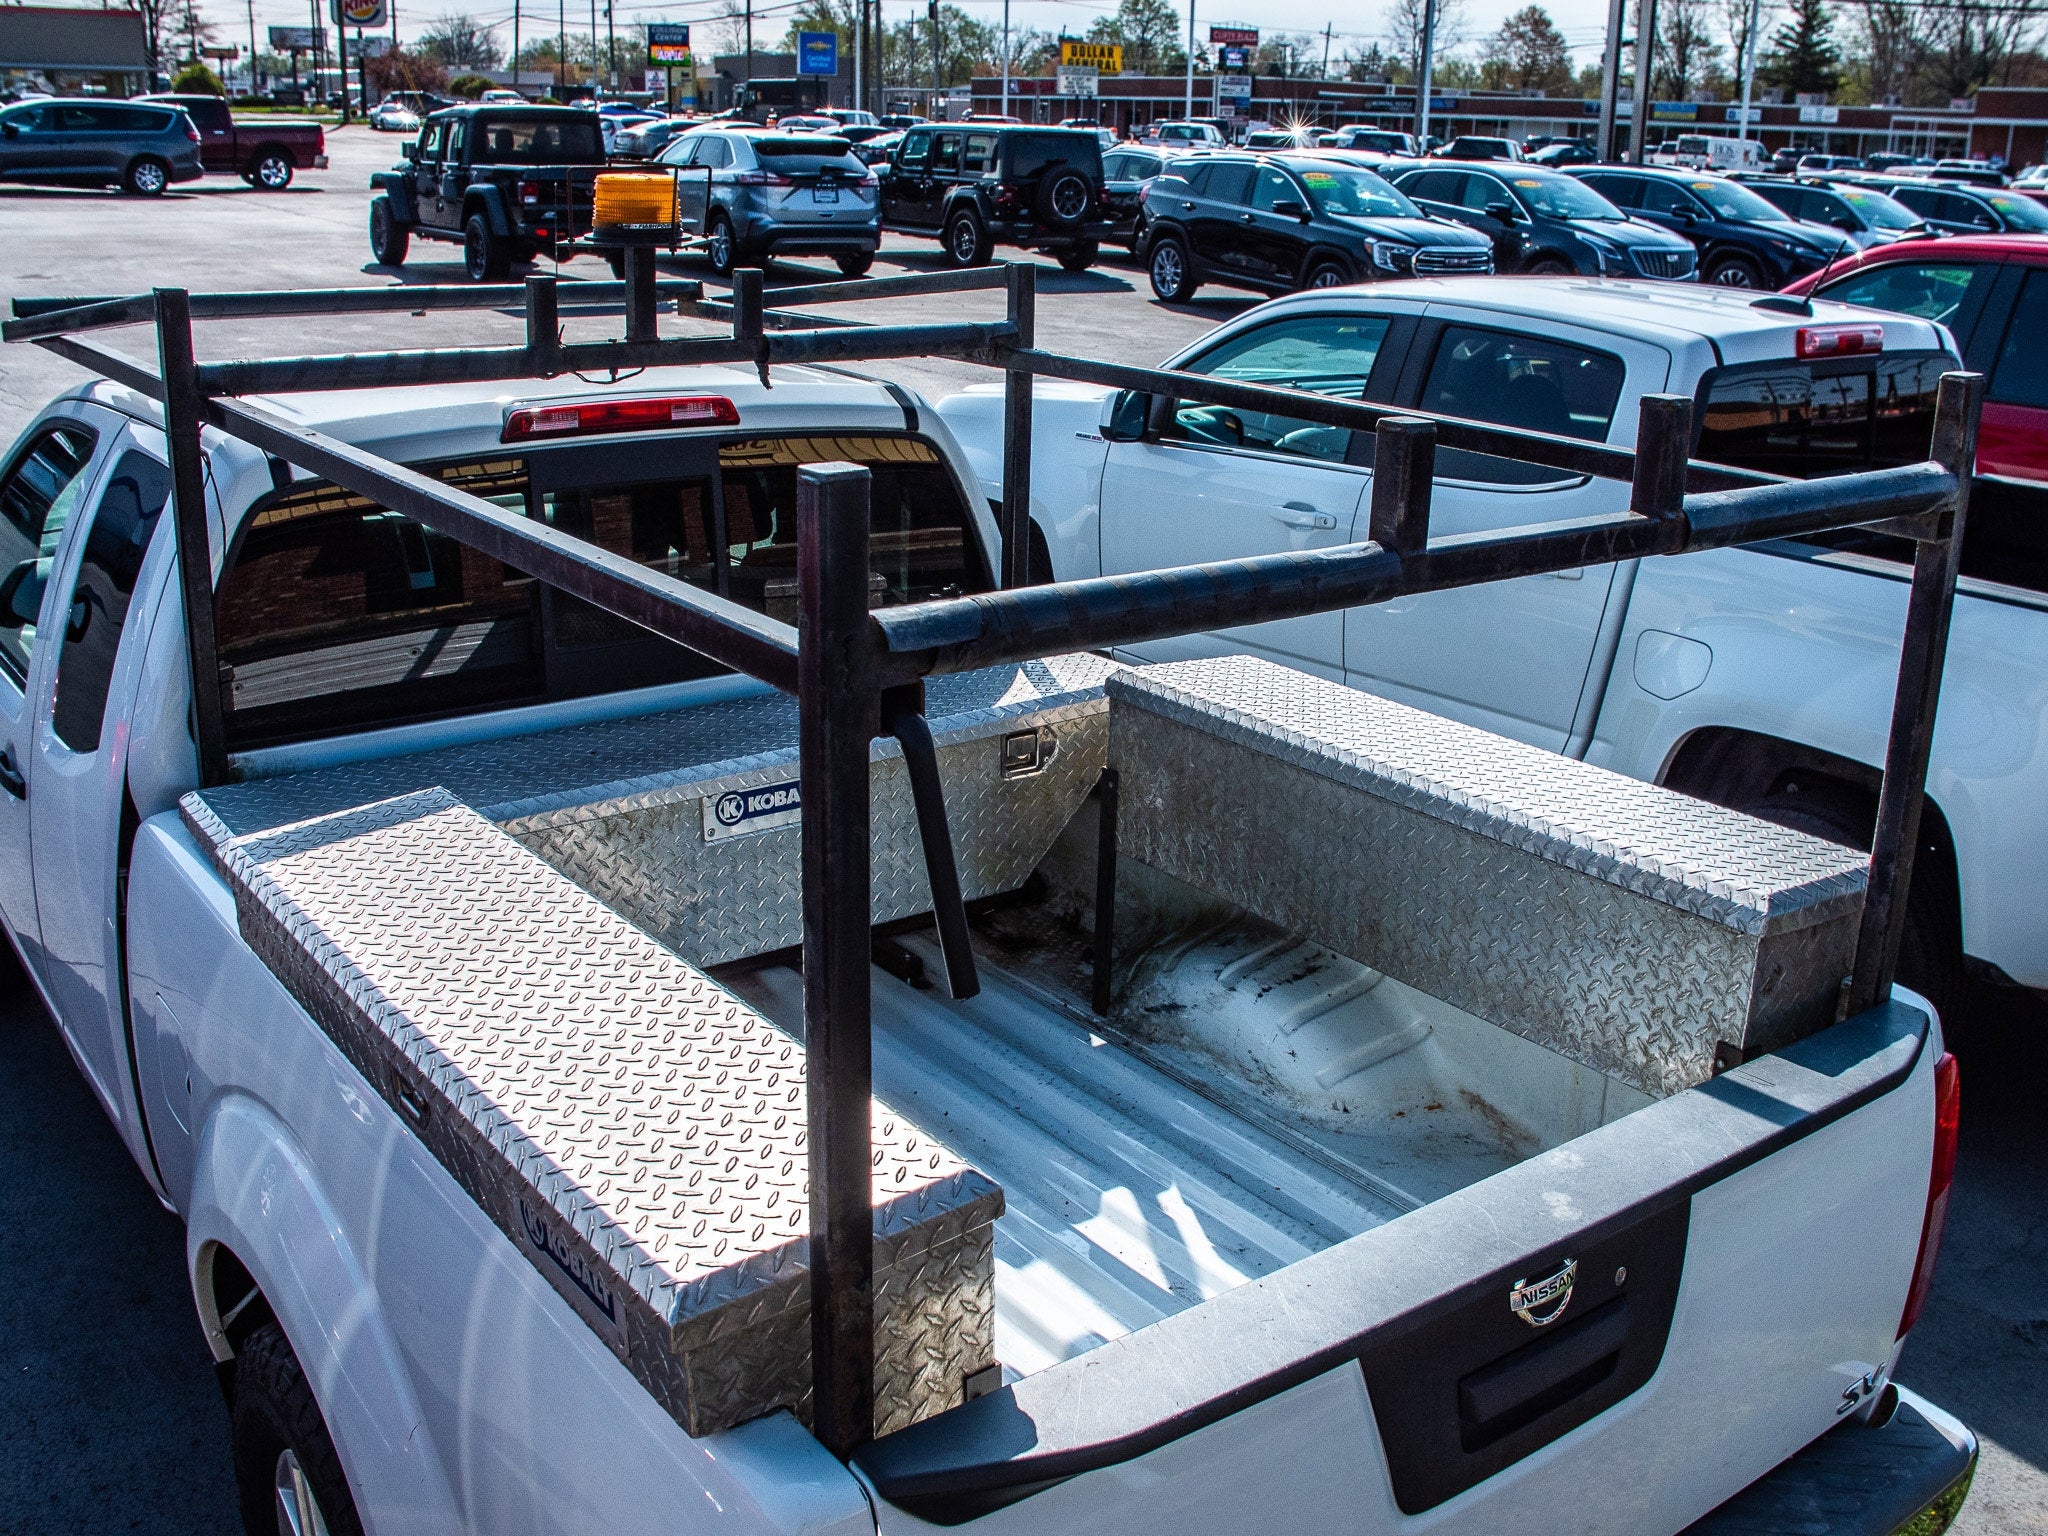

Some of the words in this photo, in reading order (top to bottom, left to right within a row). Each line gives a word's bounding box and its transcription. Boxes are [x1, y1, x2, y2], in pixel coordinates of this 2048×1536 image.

[651, 26, 687, 34] COLLISION
[1071, 45, 1114, 58] DOLLAR
[1067, 58, 1117, 71] GENERAL
[748, 790, 801, 813] KOBA
[547, 1227, 613, 1311] KOBALT
[1521, 1269, 1575, 1306] NISSAN
